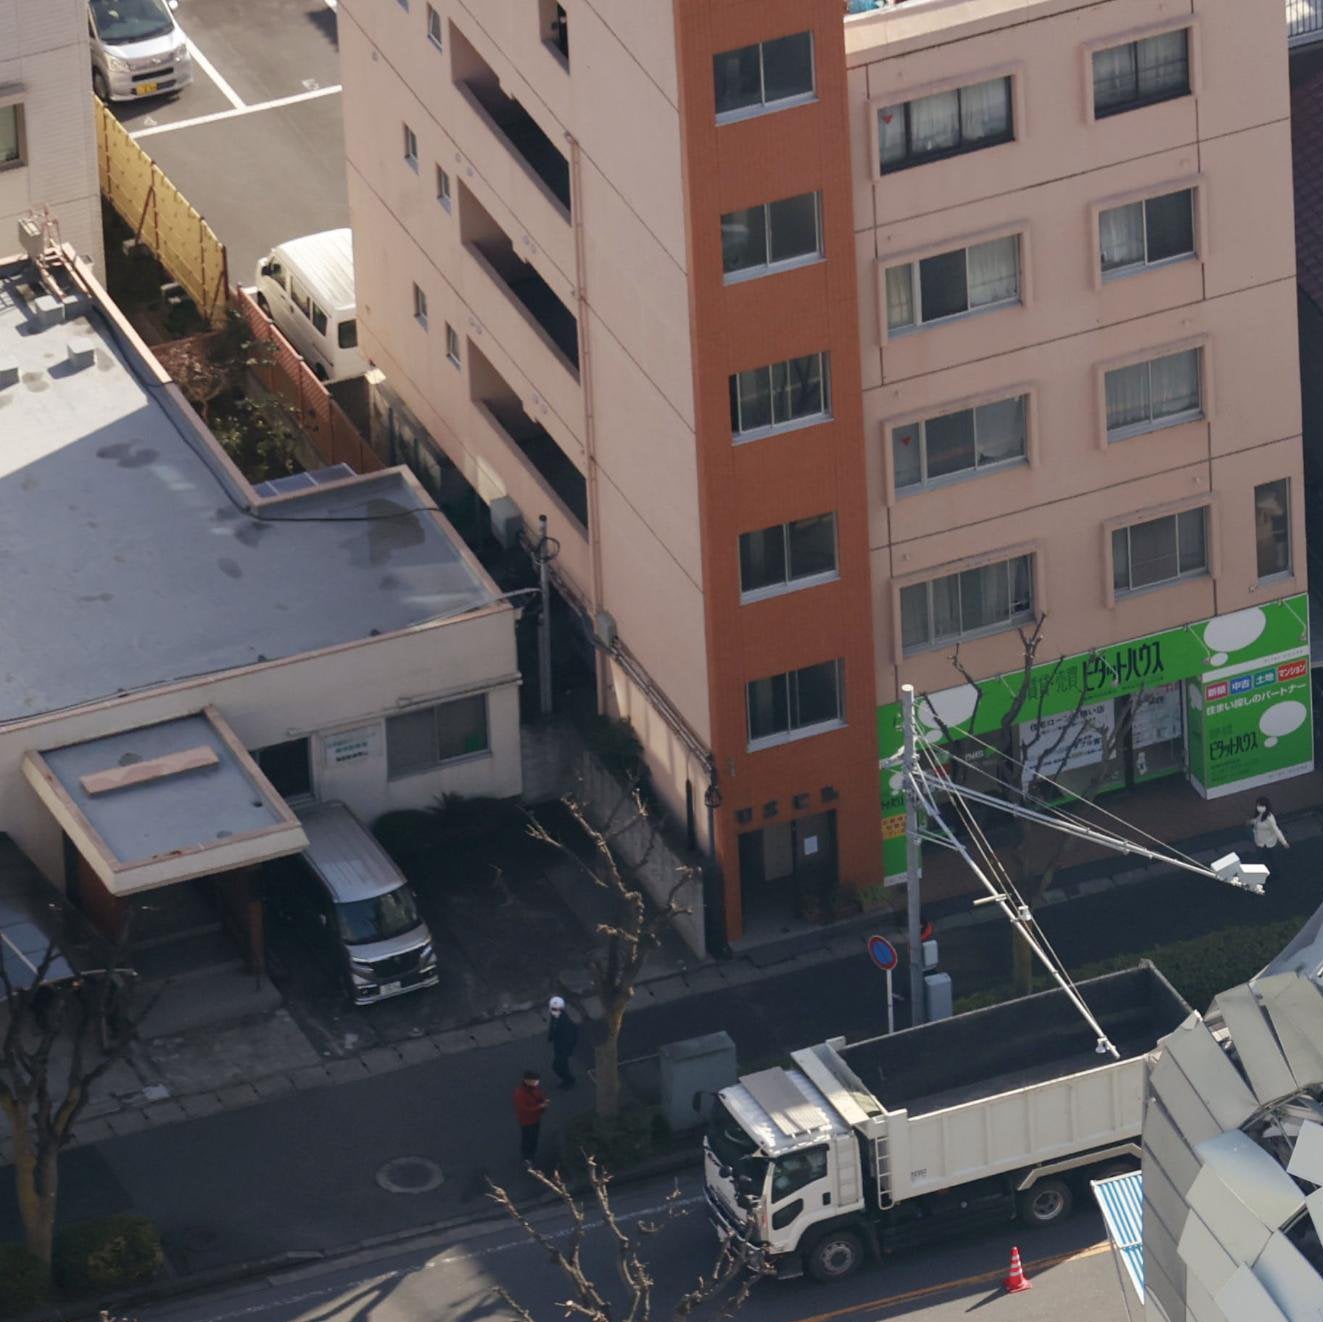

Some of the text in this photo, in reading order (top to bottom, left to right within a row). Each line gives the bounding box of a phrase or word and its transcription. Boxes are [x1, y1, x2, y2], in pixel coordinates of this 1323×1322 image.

[1278, 664, 1307, 678] マンション
[1209, 731, 1259, 761] ピタットハウス
